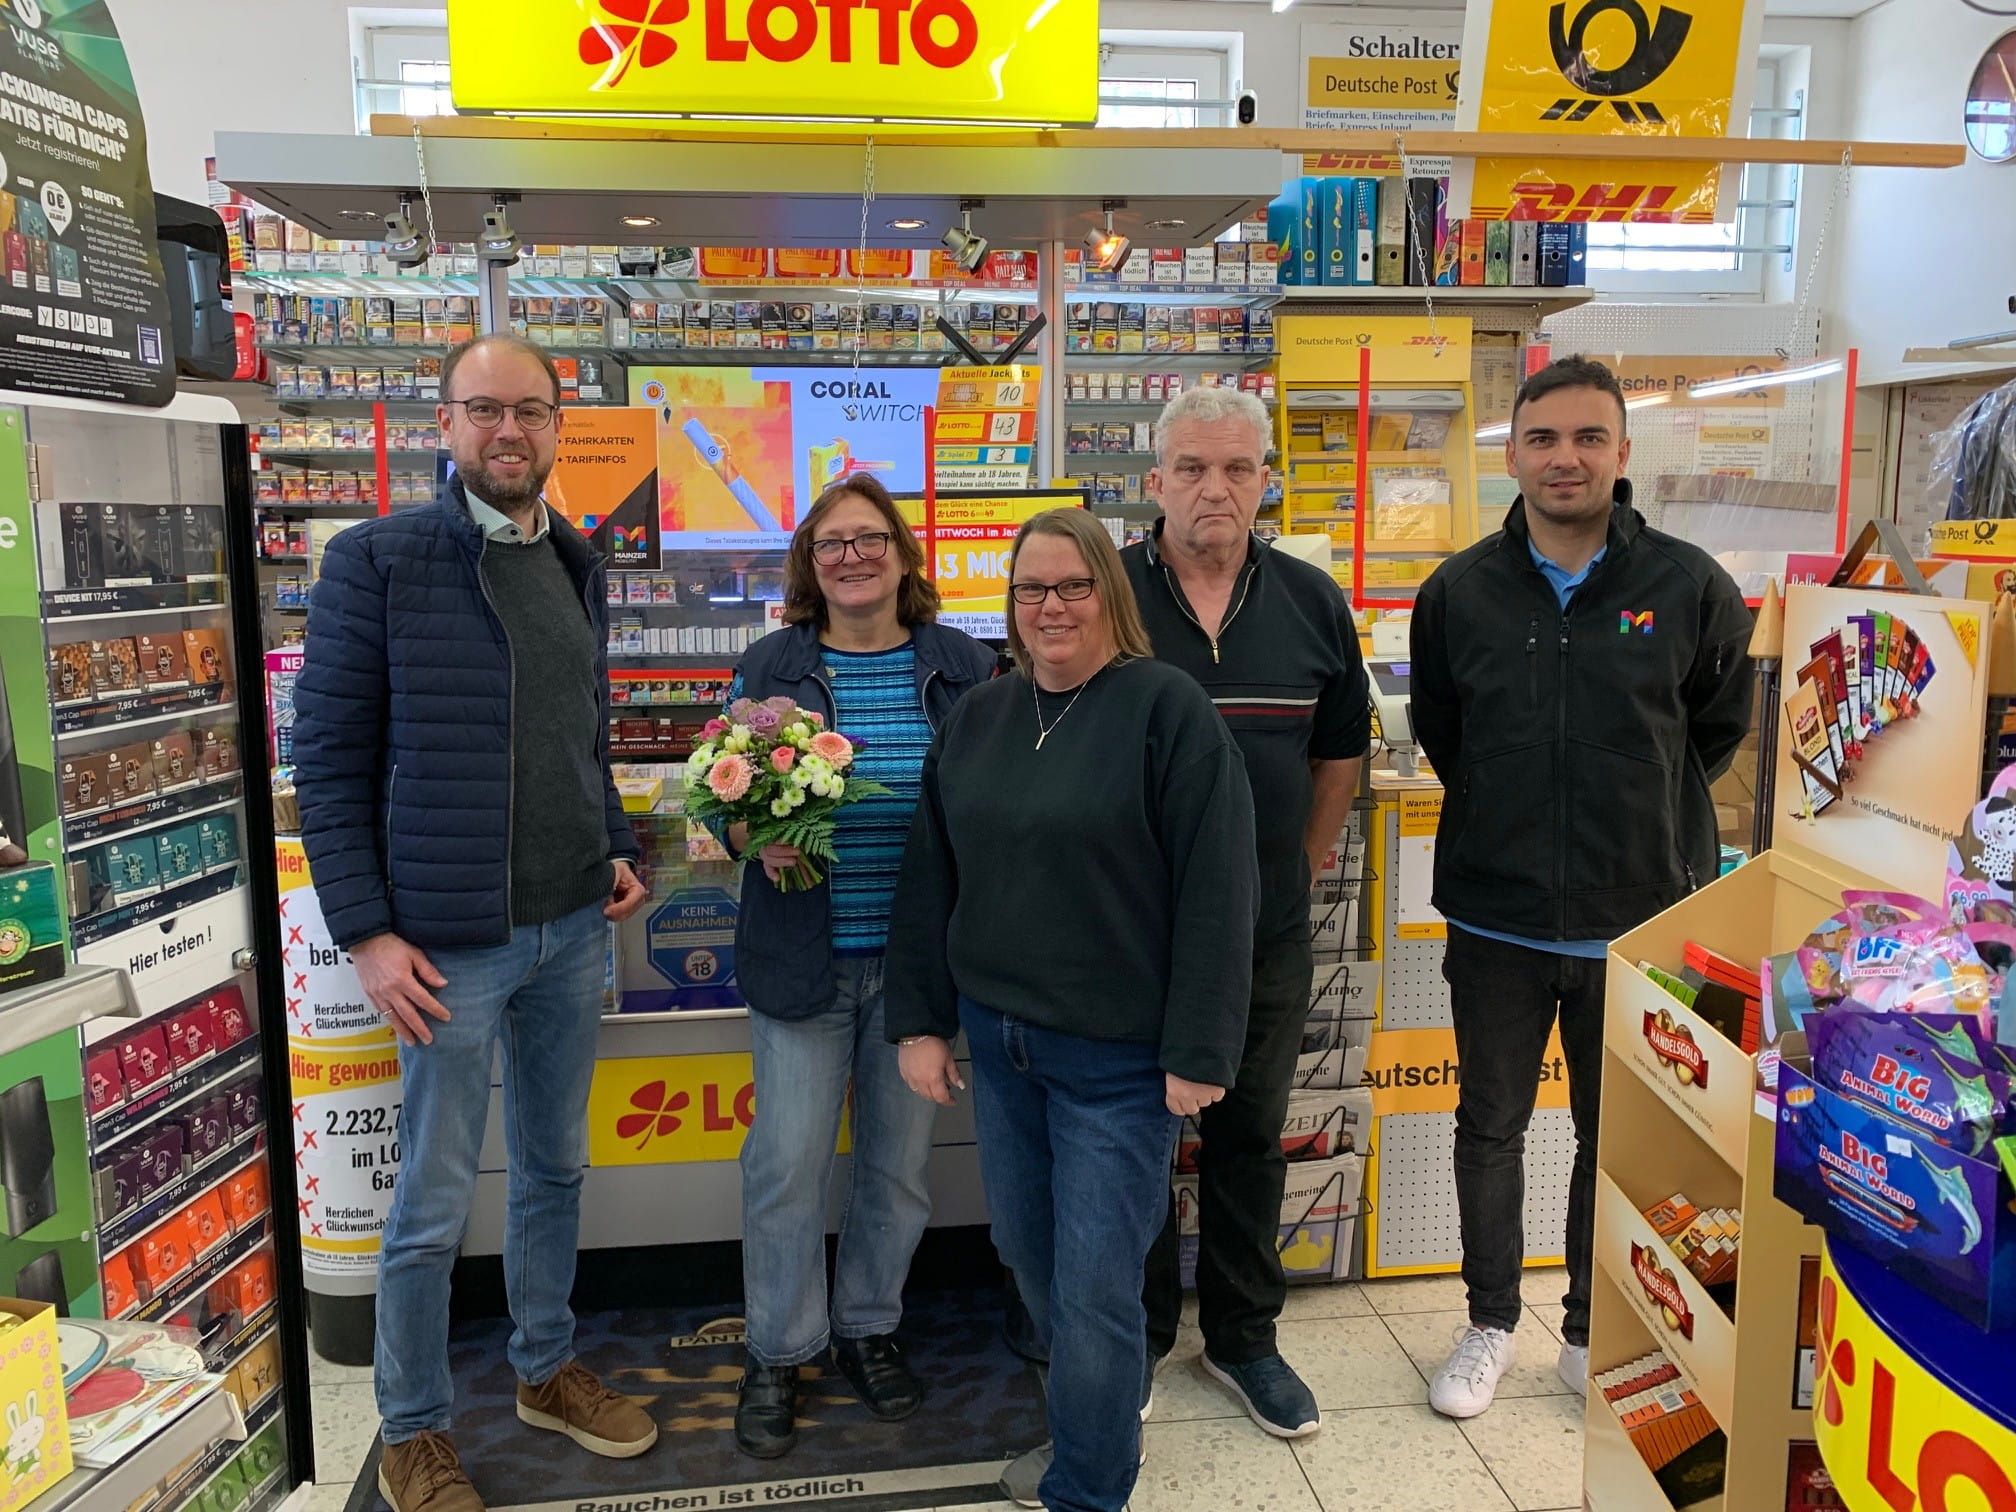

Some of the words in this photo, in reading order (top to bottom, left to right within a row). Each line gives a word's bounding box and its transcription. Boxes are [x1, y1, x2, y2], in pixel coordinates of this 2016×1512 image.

[704, 0, 979, 68] LOTTO
[1349, 35, 1460, 59] Schalter
[1325, 75, 1399, 93] Deutsche
[1404, 77, 1438, 95] Post
[84, 105, 129, 139] CAPS
[1305, 110, 1370, 121] Briefmarken,
[1373, 111, 1438, 122] Einschreiben,
[41, 112, 78, 146] FÜR
[15, 132, 41, 152] Jetzt
[44, 145, 101, 171] registrieren!
[1412, 167, 1451, 176] Retouren
[1504, 182, 1678, 223] DHL
[1296, 337, 1334, 346] Deutsche
[1335, 337, 1353, 346] Post
[950, 370, 987, 378] Aktuelle
[810, 380, 891, 399] CORAL
[999, 384, 1021, 402] 10
[994, 416, 1016, 436] 43
[565, 437, 634, 446] FAHRKARTEN
[566, 455, 627, 464] TARIFINFOS
[994, 448, 1006, 462] 3
[978, 470, 987, 478] ab
[988, 470, 996, 478] 18
[998, 470, 1022, 478] Jahren.
[974, 480, 995, 489] süchtig
[996, 480, 1021, 488] machen.
[950, 500, 968, 508] Glück
[946, 510, 969, 518] LOTTO
[984, 509, 994, 517] 49
[986, 528, 999, 537] im
[1948, 527, 1969, 541] Post
[705, 537, 722, 545] Dieses
[54, 592, 80, 605] DEVICE
[81, 592, 93, 602] KIT
[93, 591, 113, 602] 17,95
[970, 616, 990, 625] Jahren.
[188, 689, 201, 699] 7,95
[68, 711, 80, 720] Cap
[117, 700, 133, 711] 7,95
[1803, 735, 1822, 757] BLOND
[1405, 799, 1432, 808] Waren
[87, 820, 99, 829] Cap
[146, 801, 161, 812] 7,95
[1405, 809, 1419, 818] mit
[1851, 796, 1859, 808] So
[1860, 799, 1871, 812] viel
[1872, 803, 1908, 825] Geschmack
[1909, 815, 1921, 830] hat
[1922, 821, 1940, 837] nicht
[135, 903, 150, 914] 7,95
[681, 906, 717, 917] KEINE
[659, 916, 737, 930] AUSNAHMEN
[129, 949, 158, 976] Hier
[162, 931, 204, 963] testen
[309, 943, 339, 966] bei
[691, 963, 711, 976] 18
[314, 1002, 364, 1016] Herzlichen
[315, 1013, 381, 1030] Glückwunsch!
[1650, 1027, 1700, 1067] HANDELSGOLD
[291, 1053, 323, 1081] Hier
[1870, 1053, 1932, 1103] BIG
[169, 1080, 183, 1093] 7,95
[1840, 1069, 1891, 1105] ANIMAL
[1895, 1096, 1950, 1131] WORLD
[1282, 1110, 1333, 1132] ZEIT
[352, 1148, 373, 1169] im
[1842, 1131, 1888, 1180] BIG
[1819, 1144, 1865, 1184] ANIMAL
[1866, 1173, 1915, 1210] WORLD
[168, 1186, 182, 1200] 7,95
[325, 1206, 374, 1219] Herzlichen
[212, 1252, 224, 1266] 7,95
[1638, 1260, 1686, 1316] HANDELSGOLD
[719, 1488, 753, 1506] ist
[763, 1477, 865, 1502] tödlich
